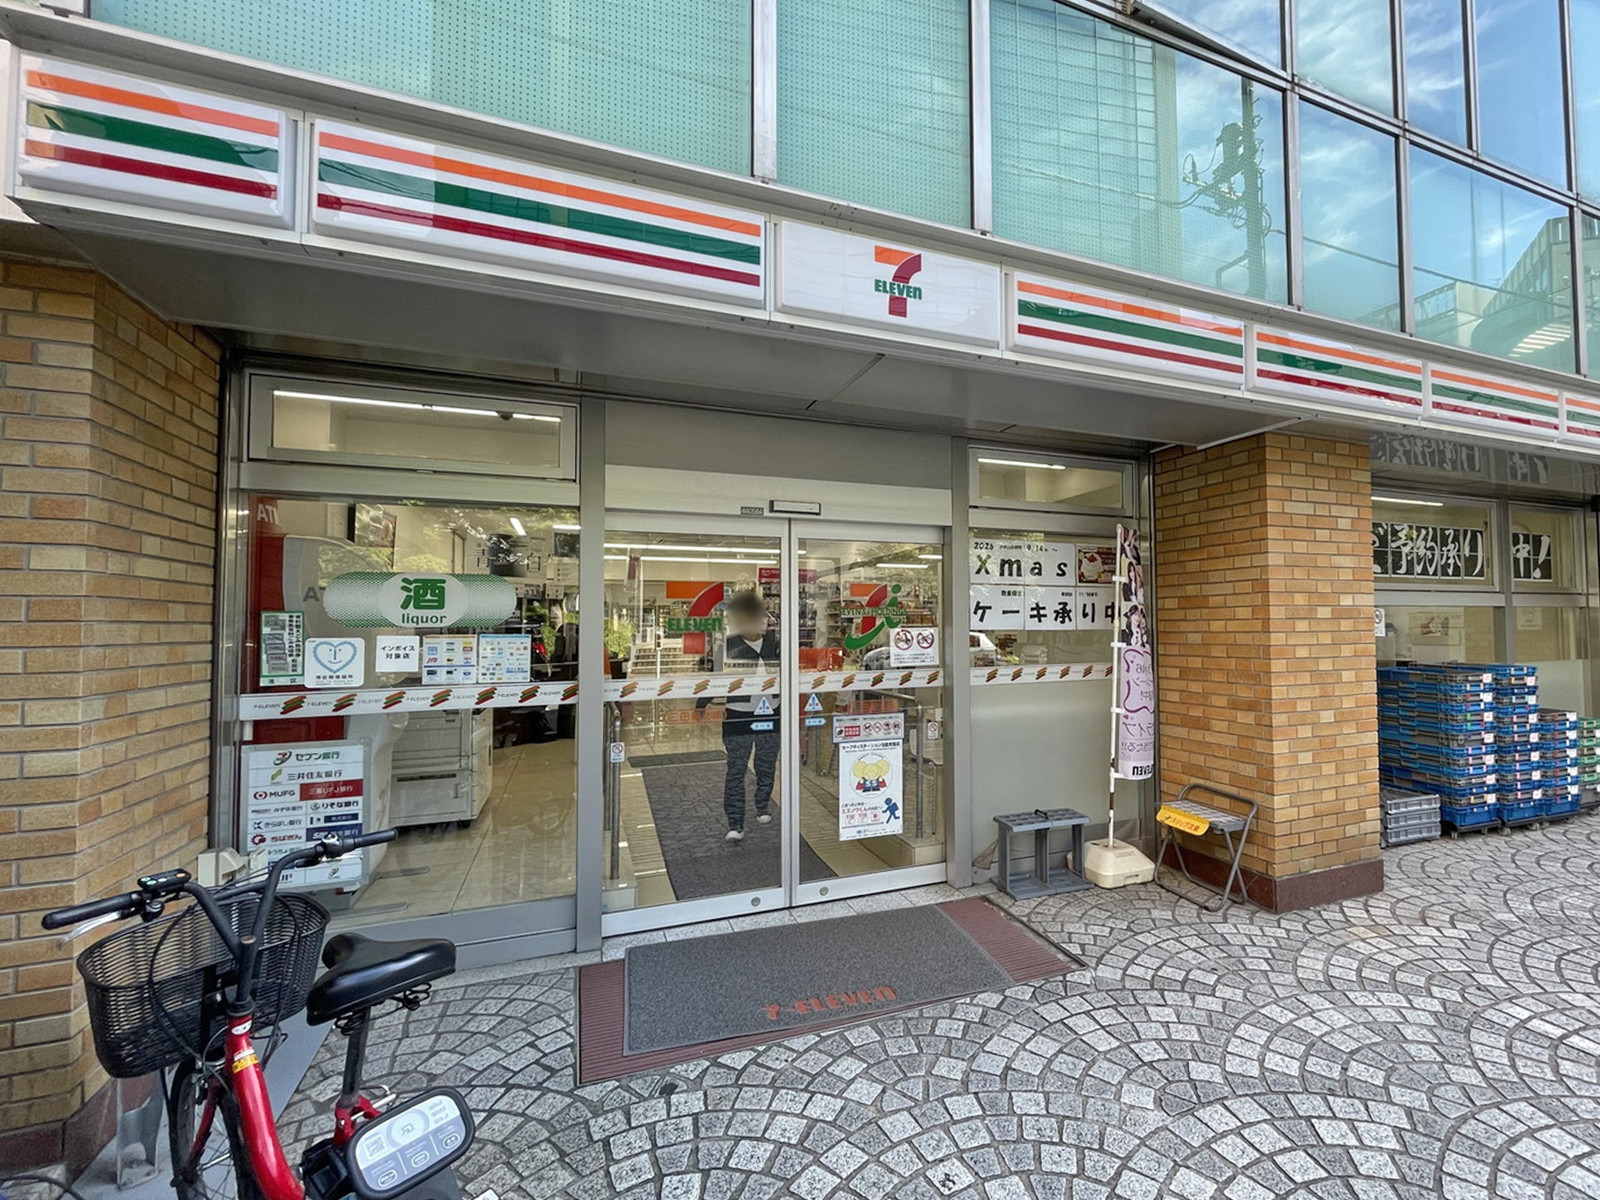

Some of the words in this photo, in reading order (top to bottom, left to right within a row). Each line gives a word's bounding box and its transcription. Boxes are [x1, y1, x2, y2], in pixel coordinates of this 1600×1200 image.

[400, 578, 447, 611] 酒
[401, 612, 447, 626] liquor
[295, 750, 340, 762] セブン銀行
[287, 769, 343, 781] 三井住友銀行
[269, 789, 296, 798] MUFG
[321, 800, 359, 809] りそな銀行
